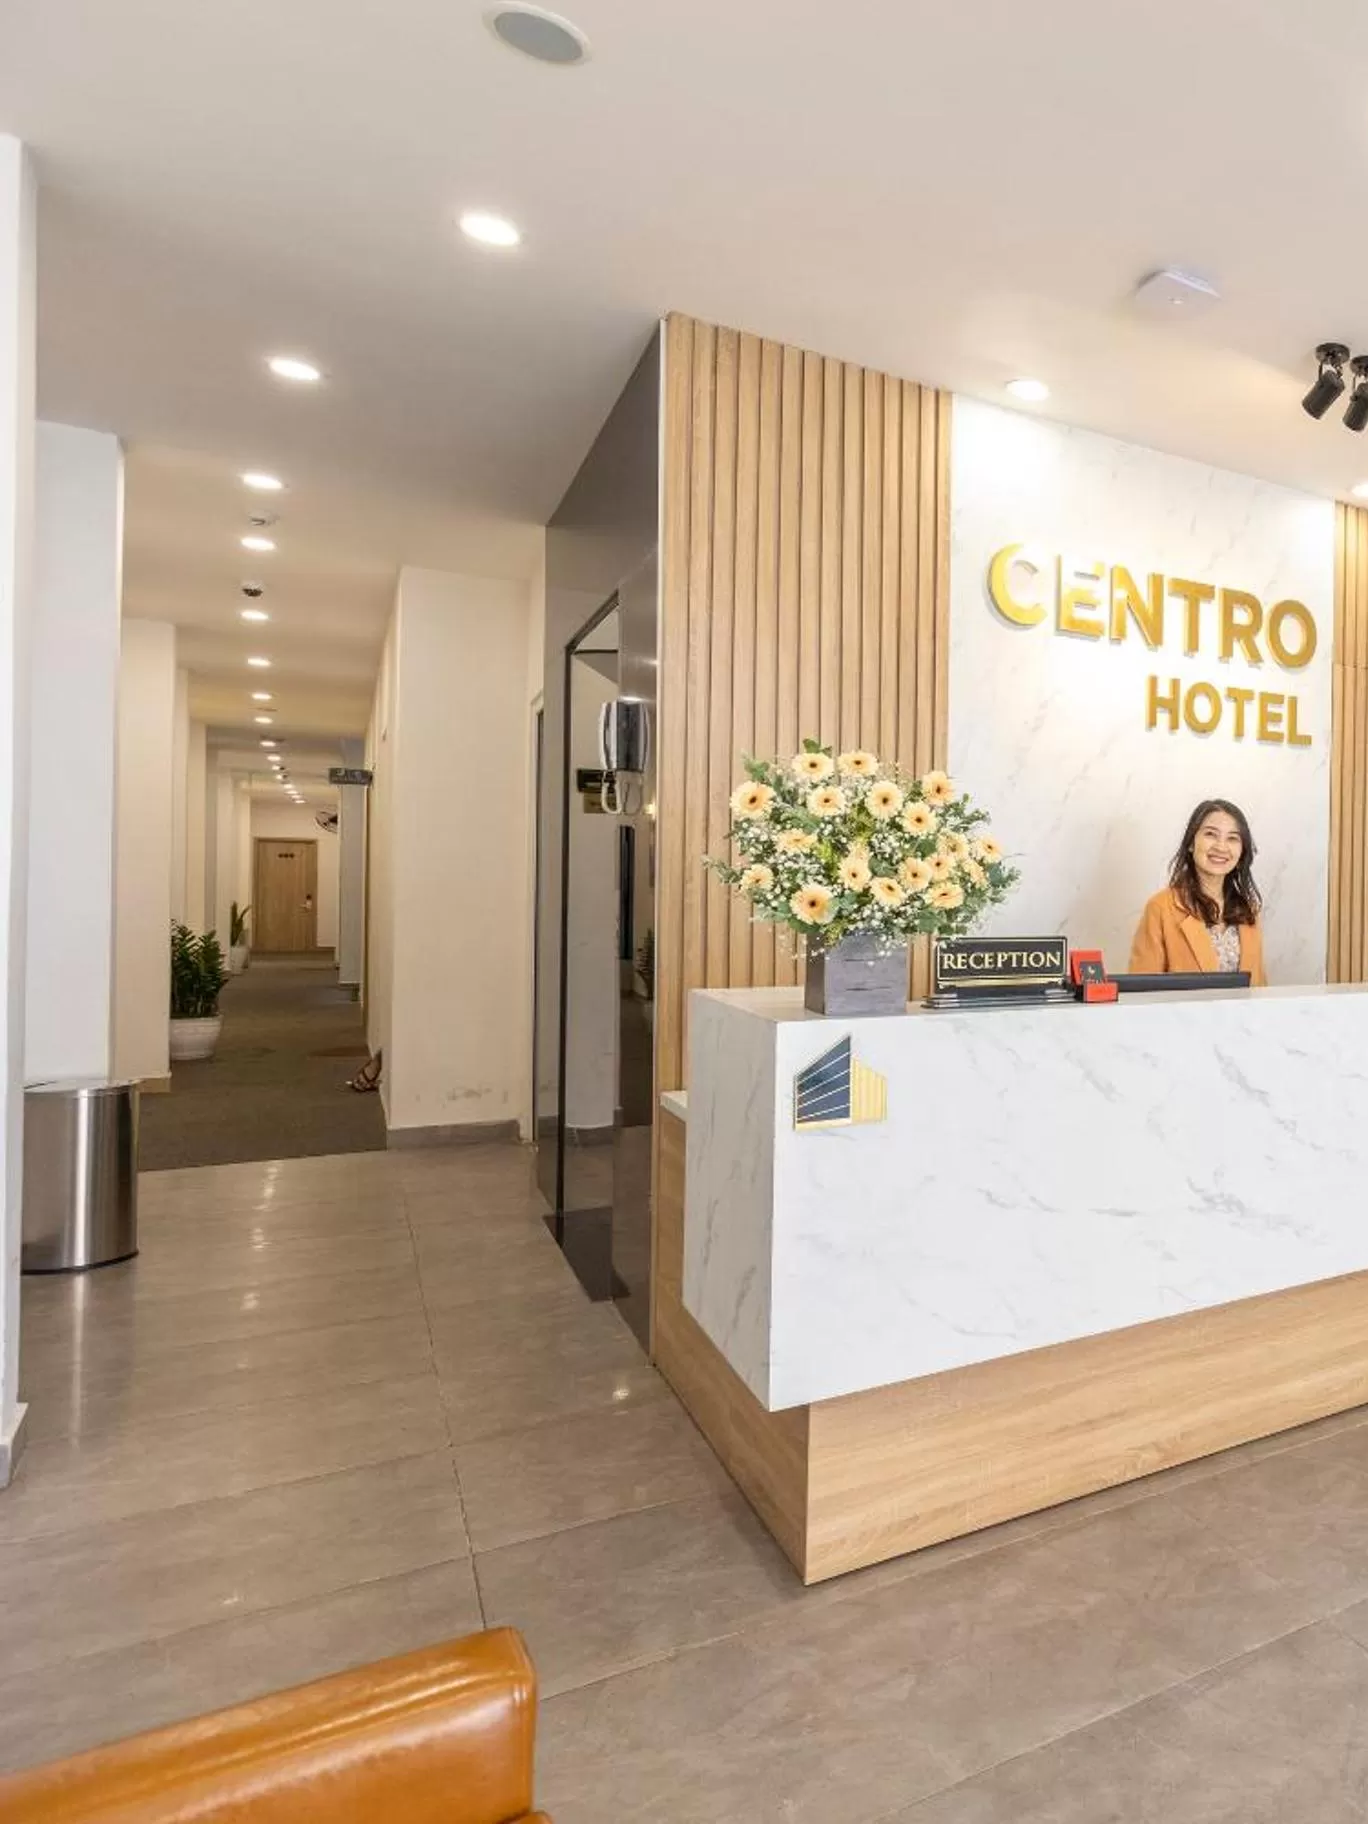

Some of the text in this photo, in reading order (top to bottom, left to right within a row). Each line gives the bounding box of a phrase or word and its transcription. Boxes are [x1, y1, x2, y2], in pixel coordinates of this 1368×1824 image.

[986, 543, 1318, 669] CENTRO
[1146, 675, 1313, 747] HOTEL
[941, 951, 1061, 970] RECEPTION
